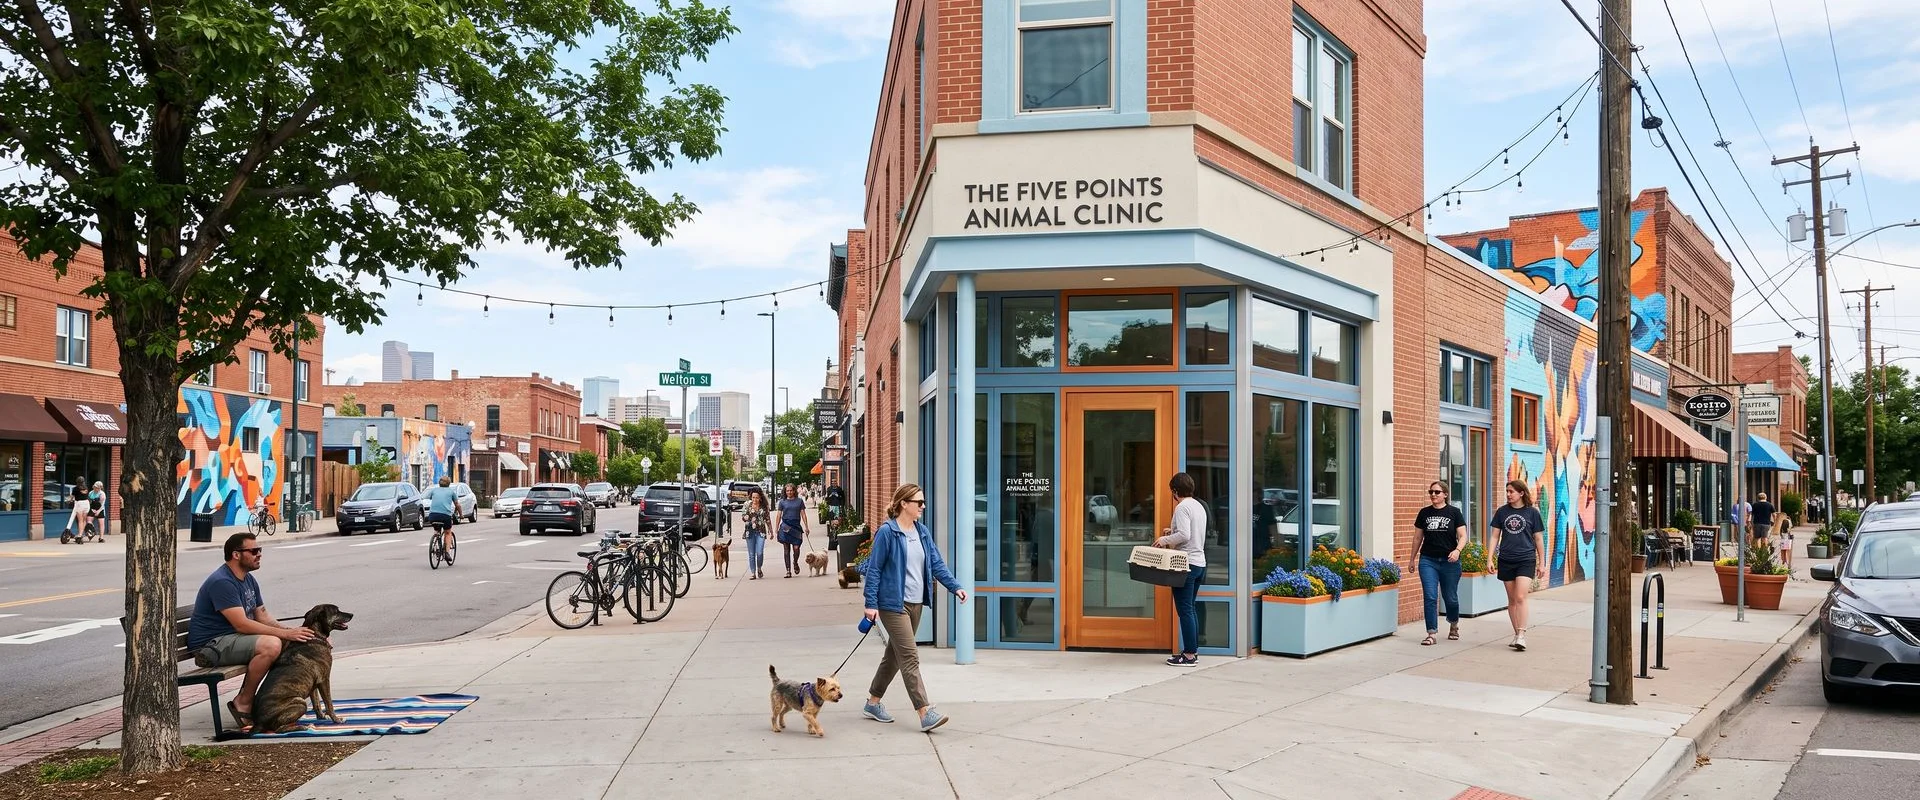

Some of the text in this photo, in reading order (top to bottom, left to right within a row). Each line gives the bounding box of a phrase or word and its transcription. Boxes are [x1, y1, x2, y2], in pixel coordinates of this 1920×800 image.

[964, 177, 1163, 203] THE FIVE POINTS
[963, 202, 1163, 229] ANIMAL CLINIC
[661, 373, 696, 384] Welton
